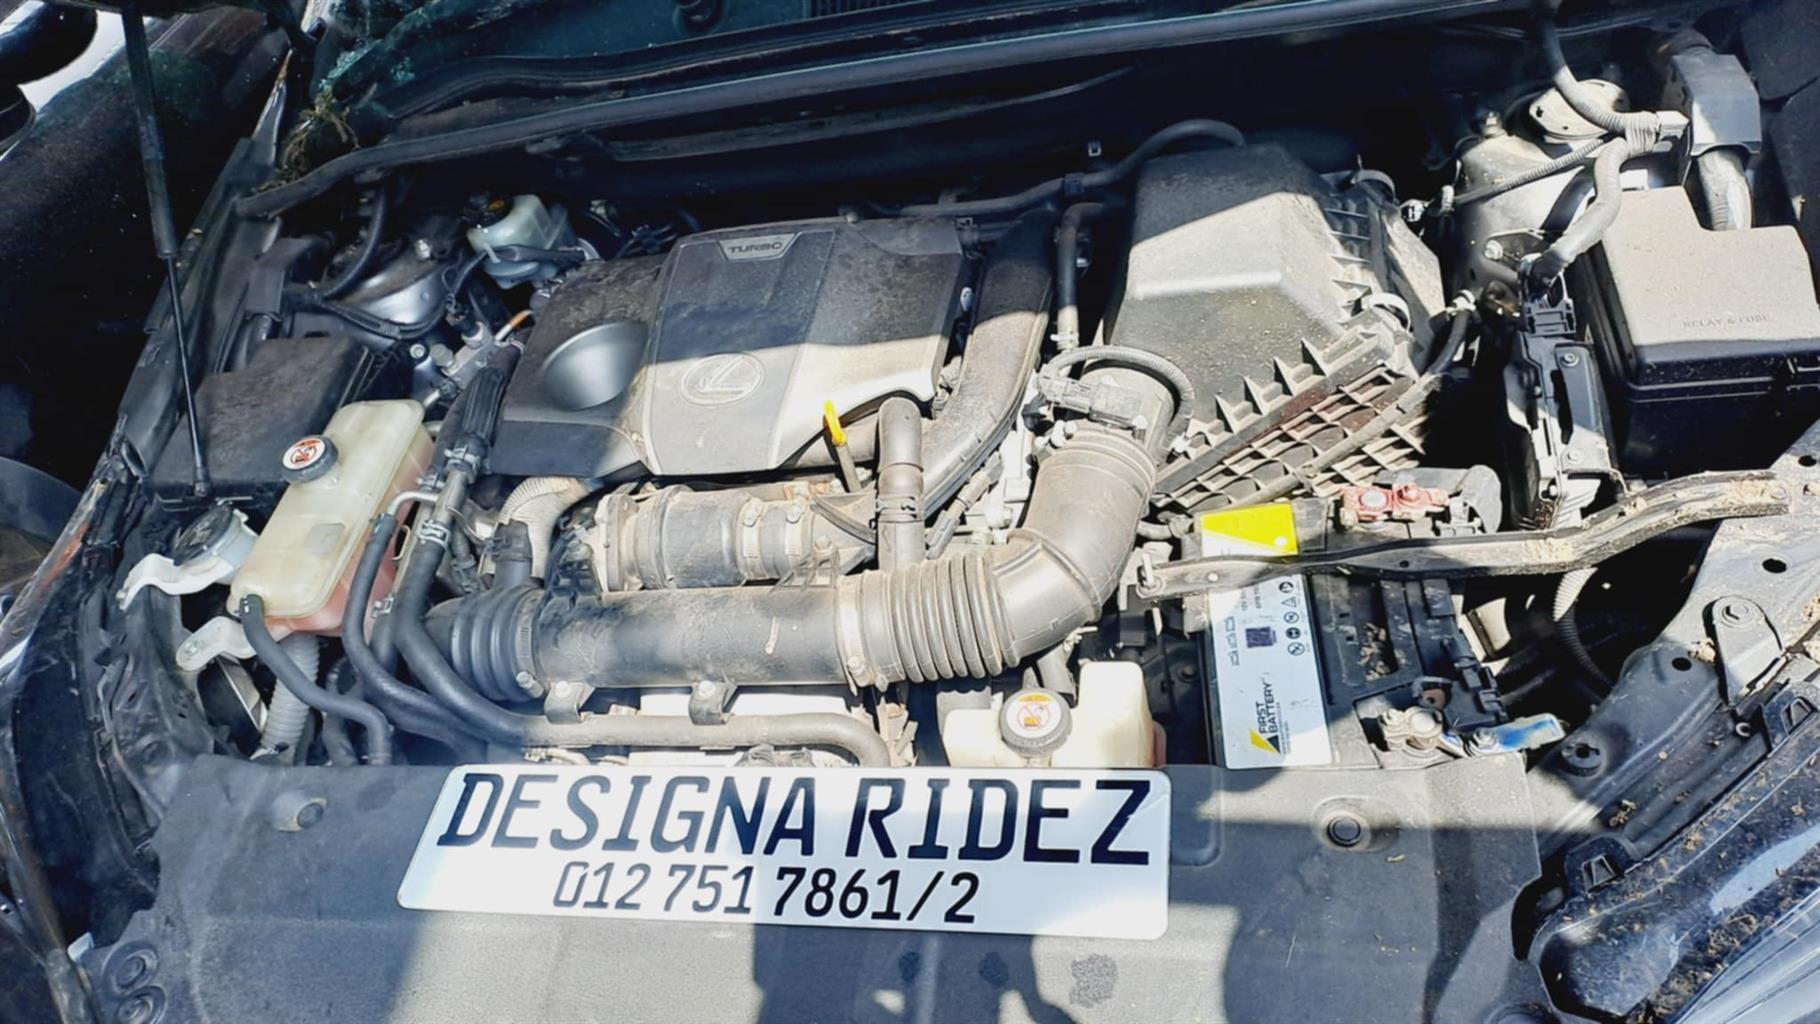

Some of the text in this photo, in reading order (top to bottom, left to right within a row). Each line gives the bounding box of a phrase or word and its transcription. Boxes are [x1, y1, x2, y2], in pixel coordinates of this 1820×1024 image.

[728, 242, 782, 253] TURBO
[1255, 700, 1268, 734] FIRST
[1263, 682, 1278, 734] BATTERY
[436, 773, 1151, 865] DESIGNA RIDEZ
[552, 861, 980, 924] 012 751 7861/2
